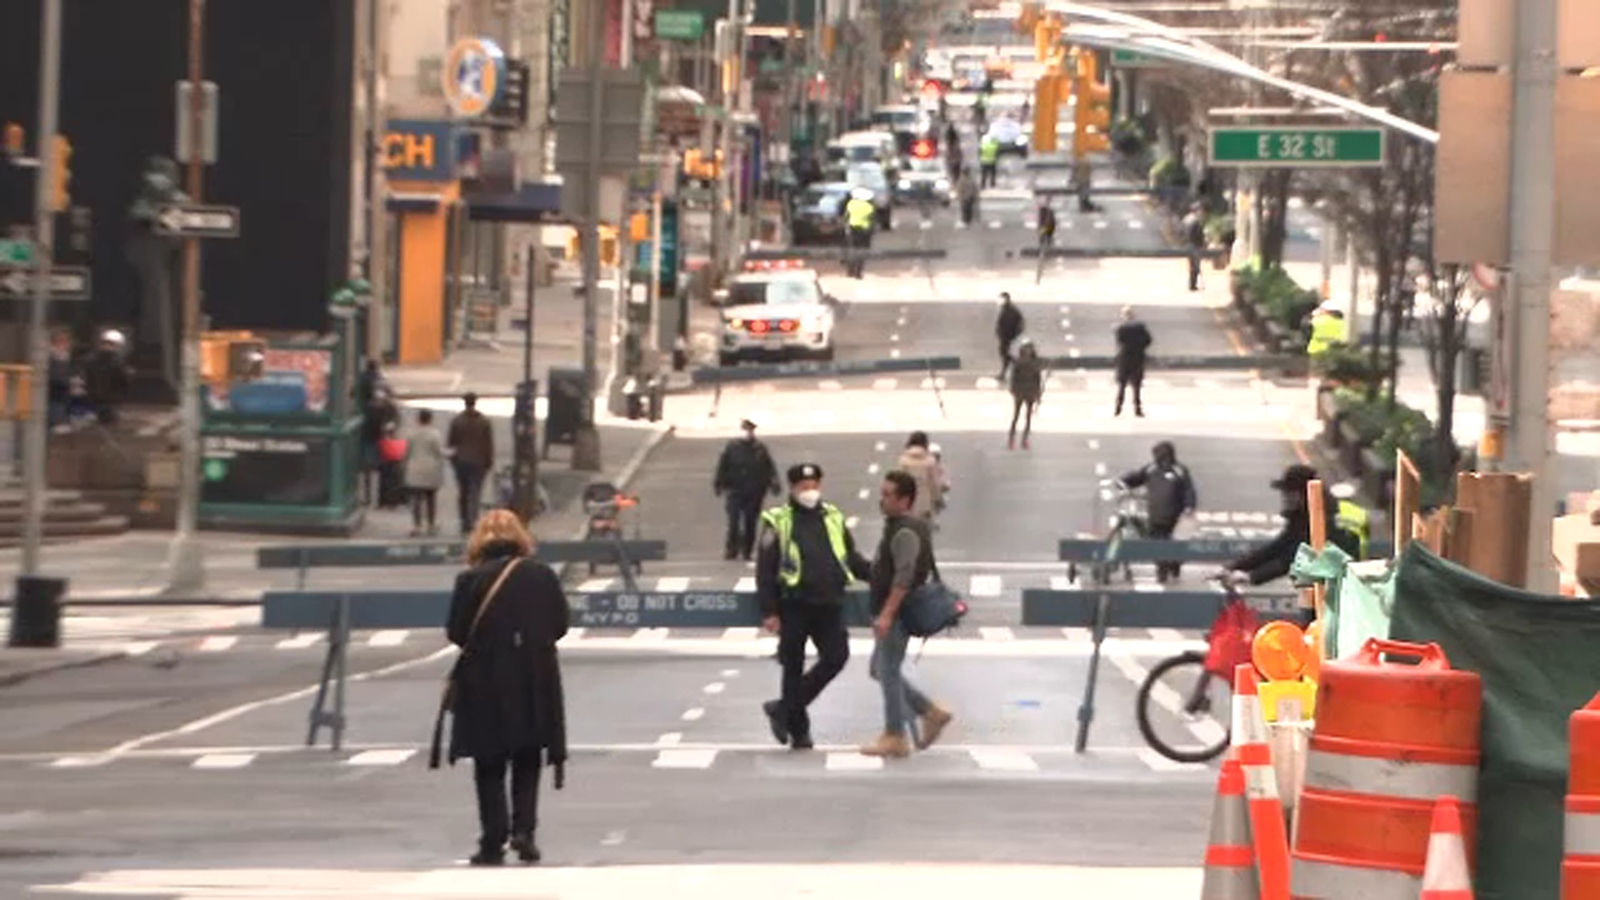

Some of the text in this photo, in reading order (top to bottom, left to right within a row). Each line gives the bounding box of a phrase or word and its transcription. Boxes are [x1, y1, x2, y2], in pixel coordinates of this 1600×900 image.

[1257, 134, 1336, 158] E 32 St
[644, 594, 677, 610] NOT
[683, 594, 738, 611] CROSS
[581, 611, 639, 624] NYPD
